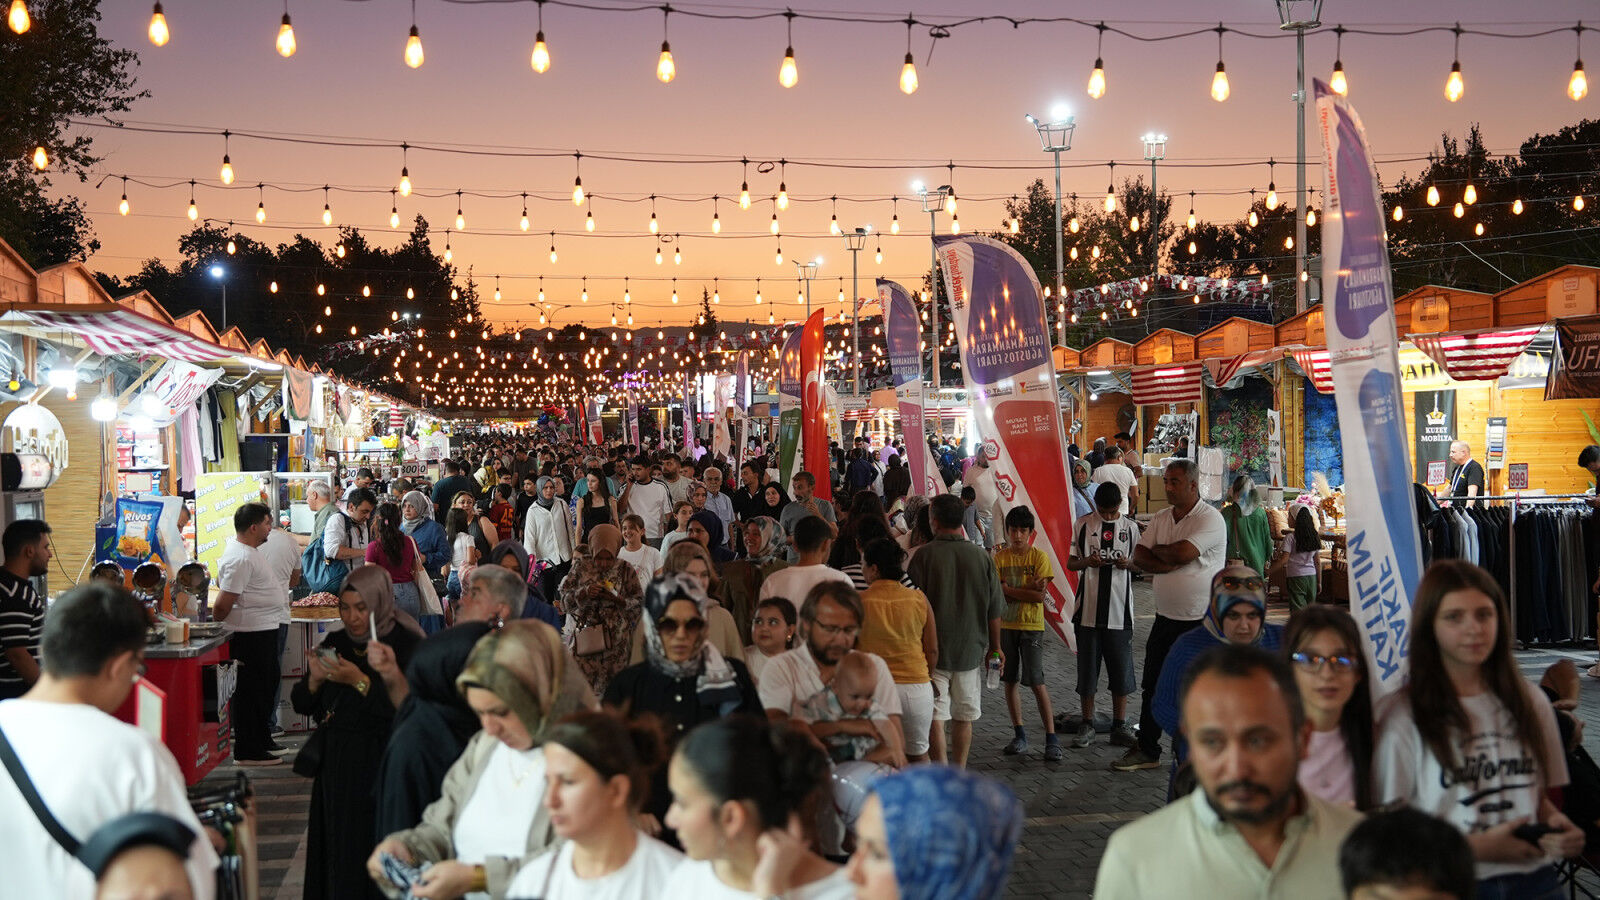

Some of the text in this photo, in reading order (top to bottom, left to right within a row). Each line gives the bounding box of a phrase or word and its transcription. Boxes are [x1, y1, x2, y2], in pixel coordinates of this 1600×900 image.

[1421, 433, 1453, 442] MOBİLYA
[1510, 472, 1526, 487] 999
[243, 489, 260, 503] Rivo
[124, 511, 152, 522] Rivos
